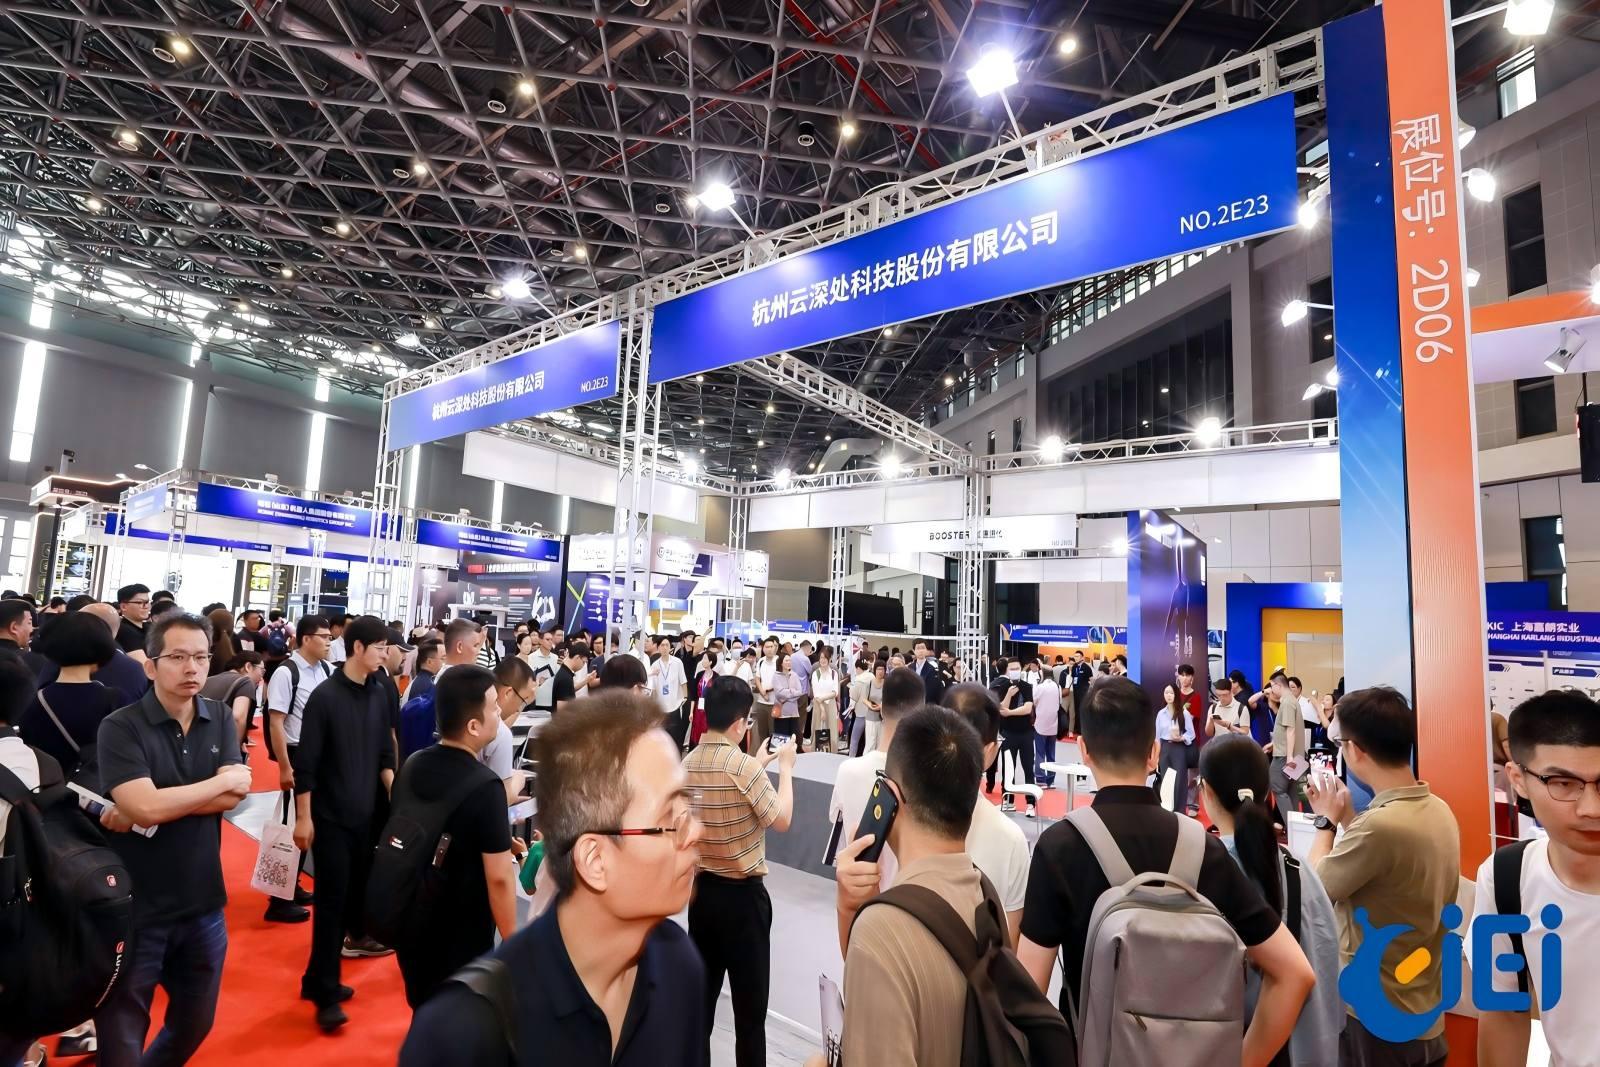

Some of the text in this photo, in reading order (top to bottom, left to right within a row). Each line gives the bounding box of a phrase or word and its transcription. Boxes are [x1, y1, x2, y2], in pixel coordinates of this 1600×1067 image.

[1179, 194, 1271, 236] NO.2E23
[751, 210, 1060, 329] 杭州云深处科技股份有限公司
[1411, 258, 1454, 363] 2D06
[432, 370, 545, 421] 杭州云深处科技股份有限公司
[580, 375, 609, 393] NO.2E23
[929, 530, 970, 541] BOOSTER
[1487, 633, 1520, 641] HANGHAI
